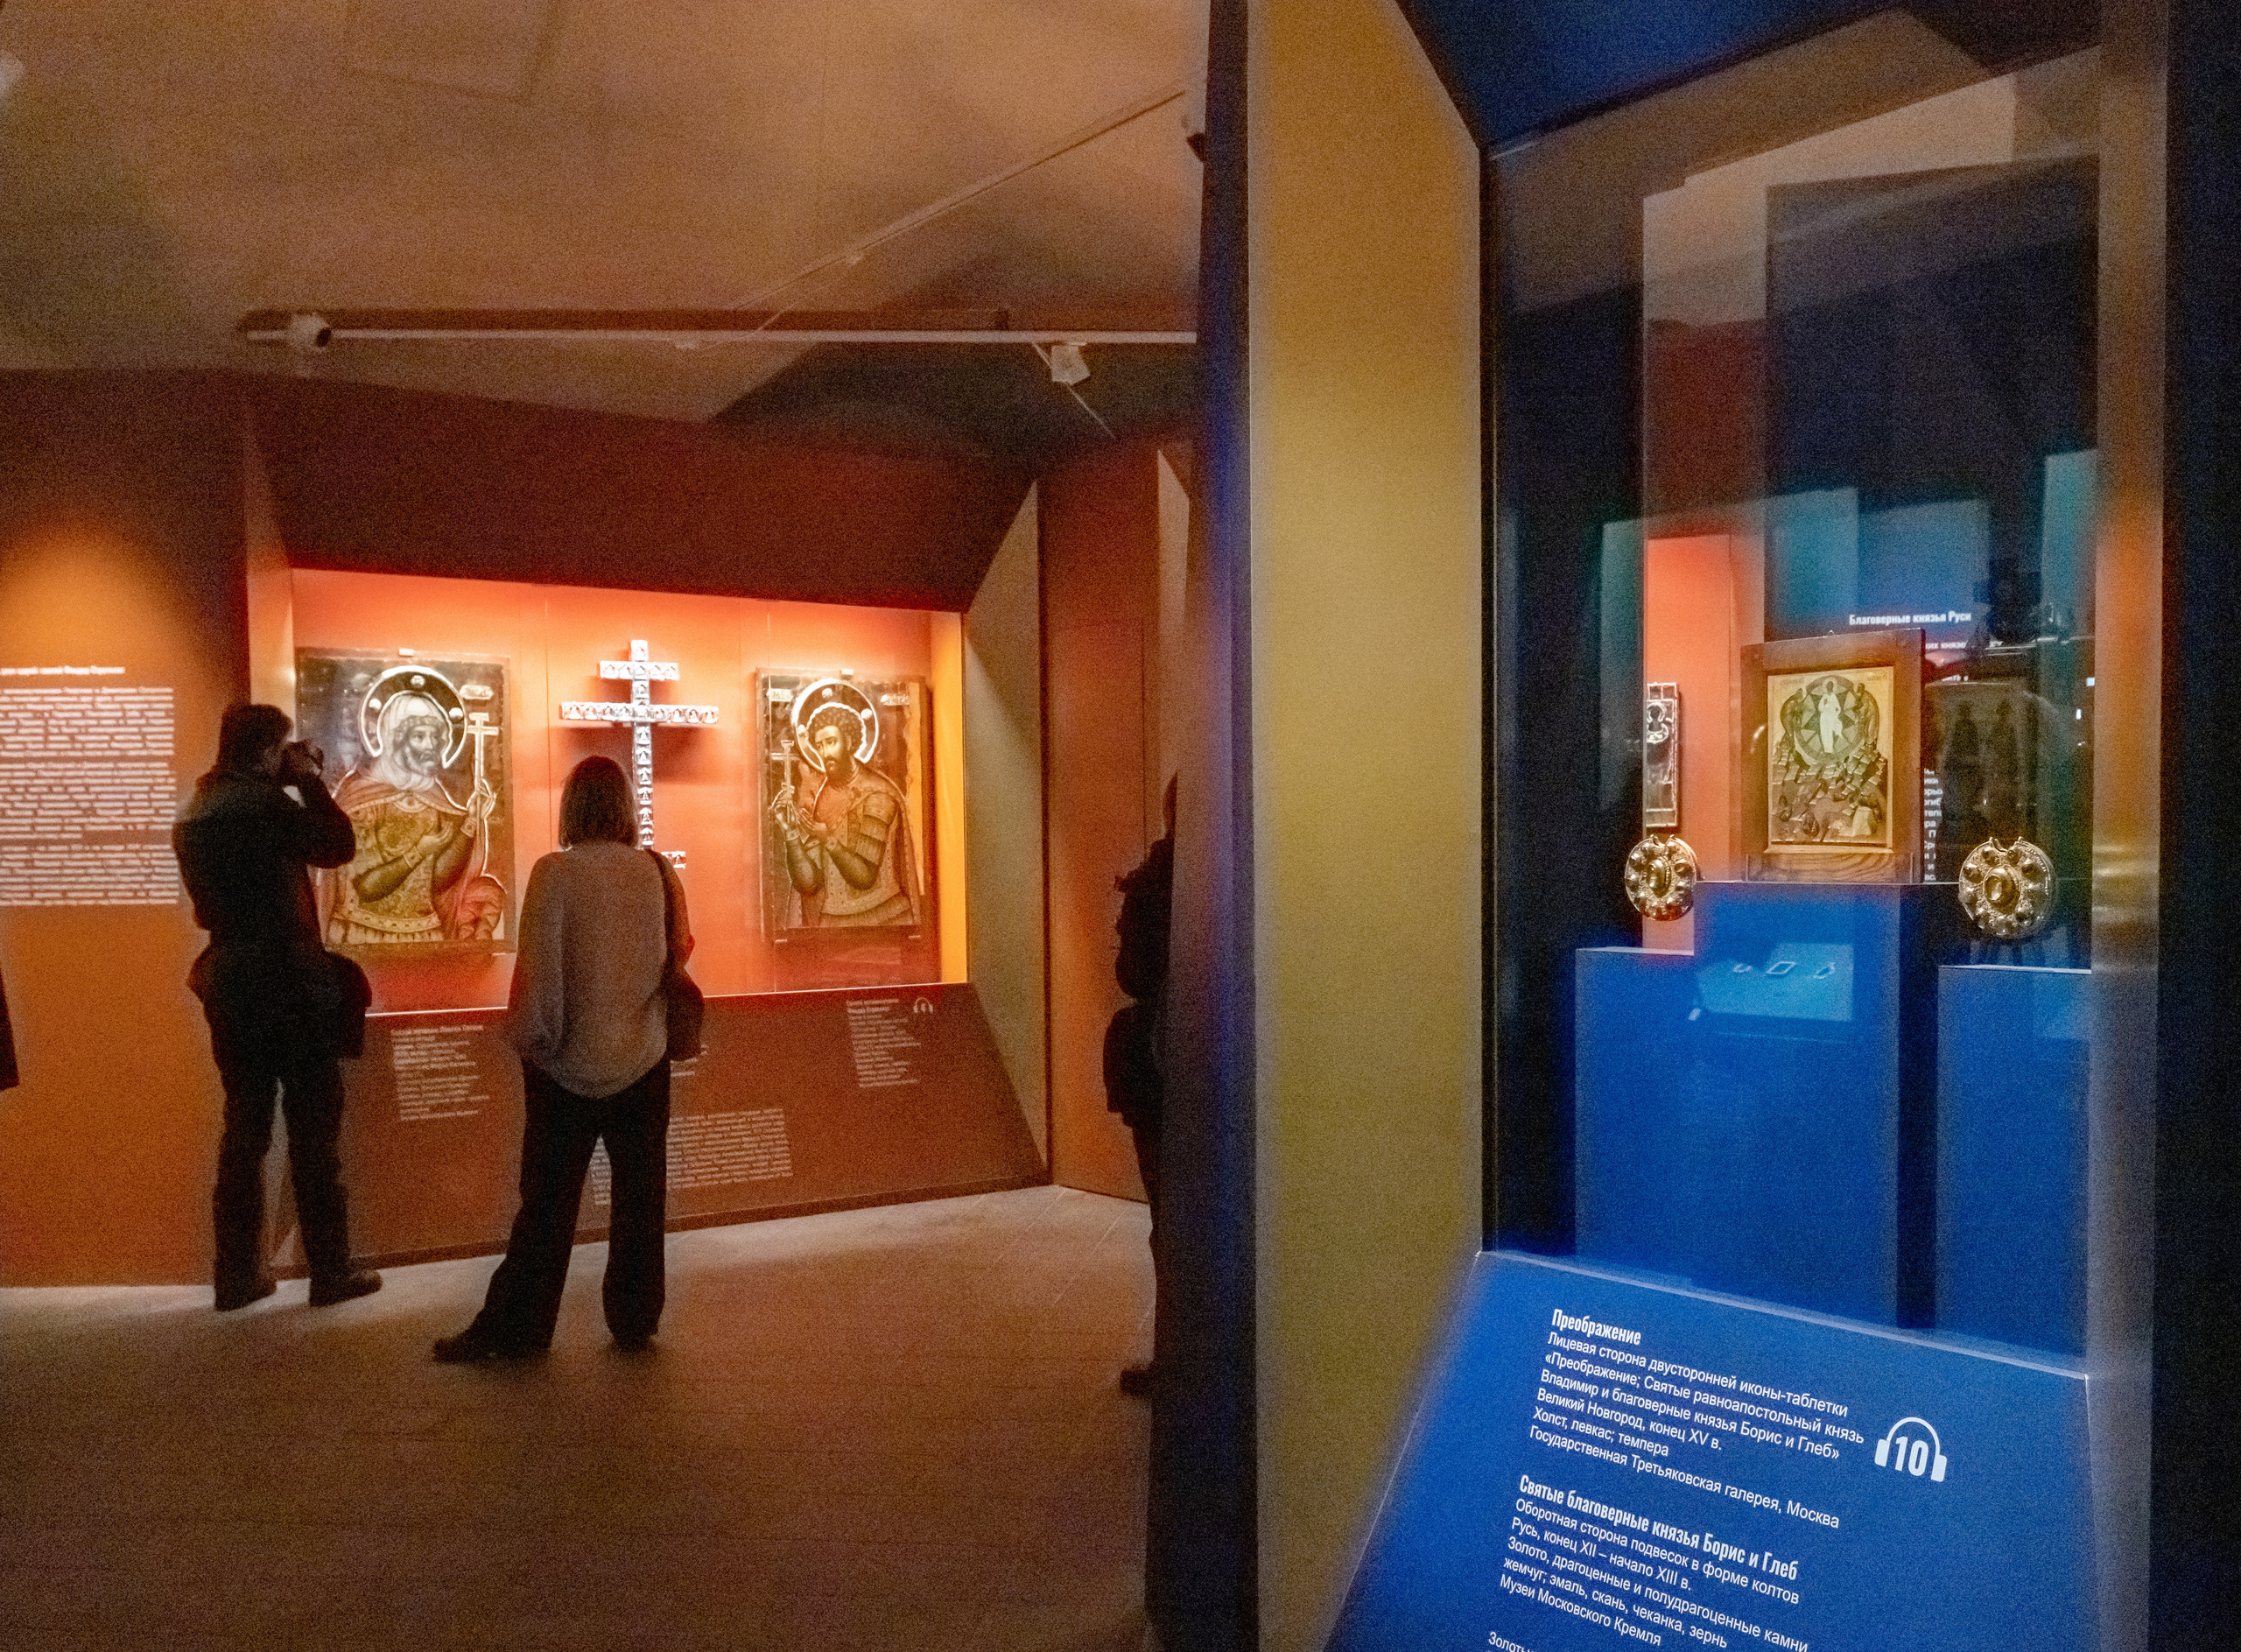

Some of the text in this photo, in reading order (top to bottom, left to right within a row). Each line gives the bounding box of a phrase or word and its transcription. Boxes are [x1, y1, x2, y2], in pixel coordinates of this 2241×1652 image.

[1849, 610, 1971, 626] Благоверные князья Руси
[1551, 1308, 1642, 1346] Преображение
[1541, 1368, 1840, 1459] Владимир и благоверные князья Борис и Глеб»
[1544, 1351, 1865, 1444] «Преображение; Святые равноапостольный князь
[1547, 1331, 1849, 1417] Лицевая сторона двусторонней иконы-таблетки
[1532, 1405, 1669, 1457] Холст, левкас; темпера
[1536, 1387, 1722, 1451] Великий Новгород, конец XV в.
[1895, 1437, 1928, 1476] 10
[1529, 1424, 1840, 1529] Государственная Третьяковская галерея, Москва
[1511, 1516, 1541, 1541] Русь,
[1543, 1530, 1577, 1553] конец
[1579, 1539, 1597, 1557] XII
[1609, 1553, 1654, 1578] начало
[1655, 1565, 1678, 1585] XIII
[1680, 1577, 1691, 1591] в.
[1515, 1498, 1800, 1605] Оборотная сторона подвесок в форме колтов
[1519, 1474, 1799, 1581] Святые благоверные князья Борис и Глеб
[1500, 1573, 1661, 1647] Музеи Московского Кремля
[1503, 1557, 1728, 1648] жемчуг; эмаль, скань, чеканка, зернь
[1507, 1536, 1809, 1652] Золото, драгоценные и полудрагоценные камни
